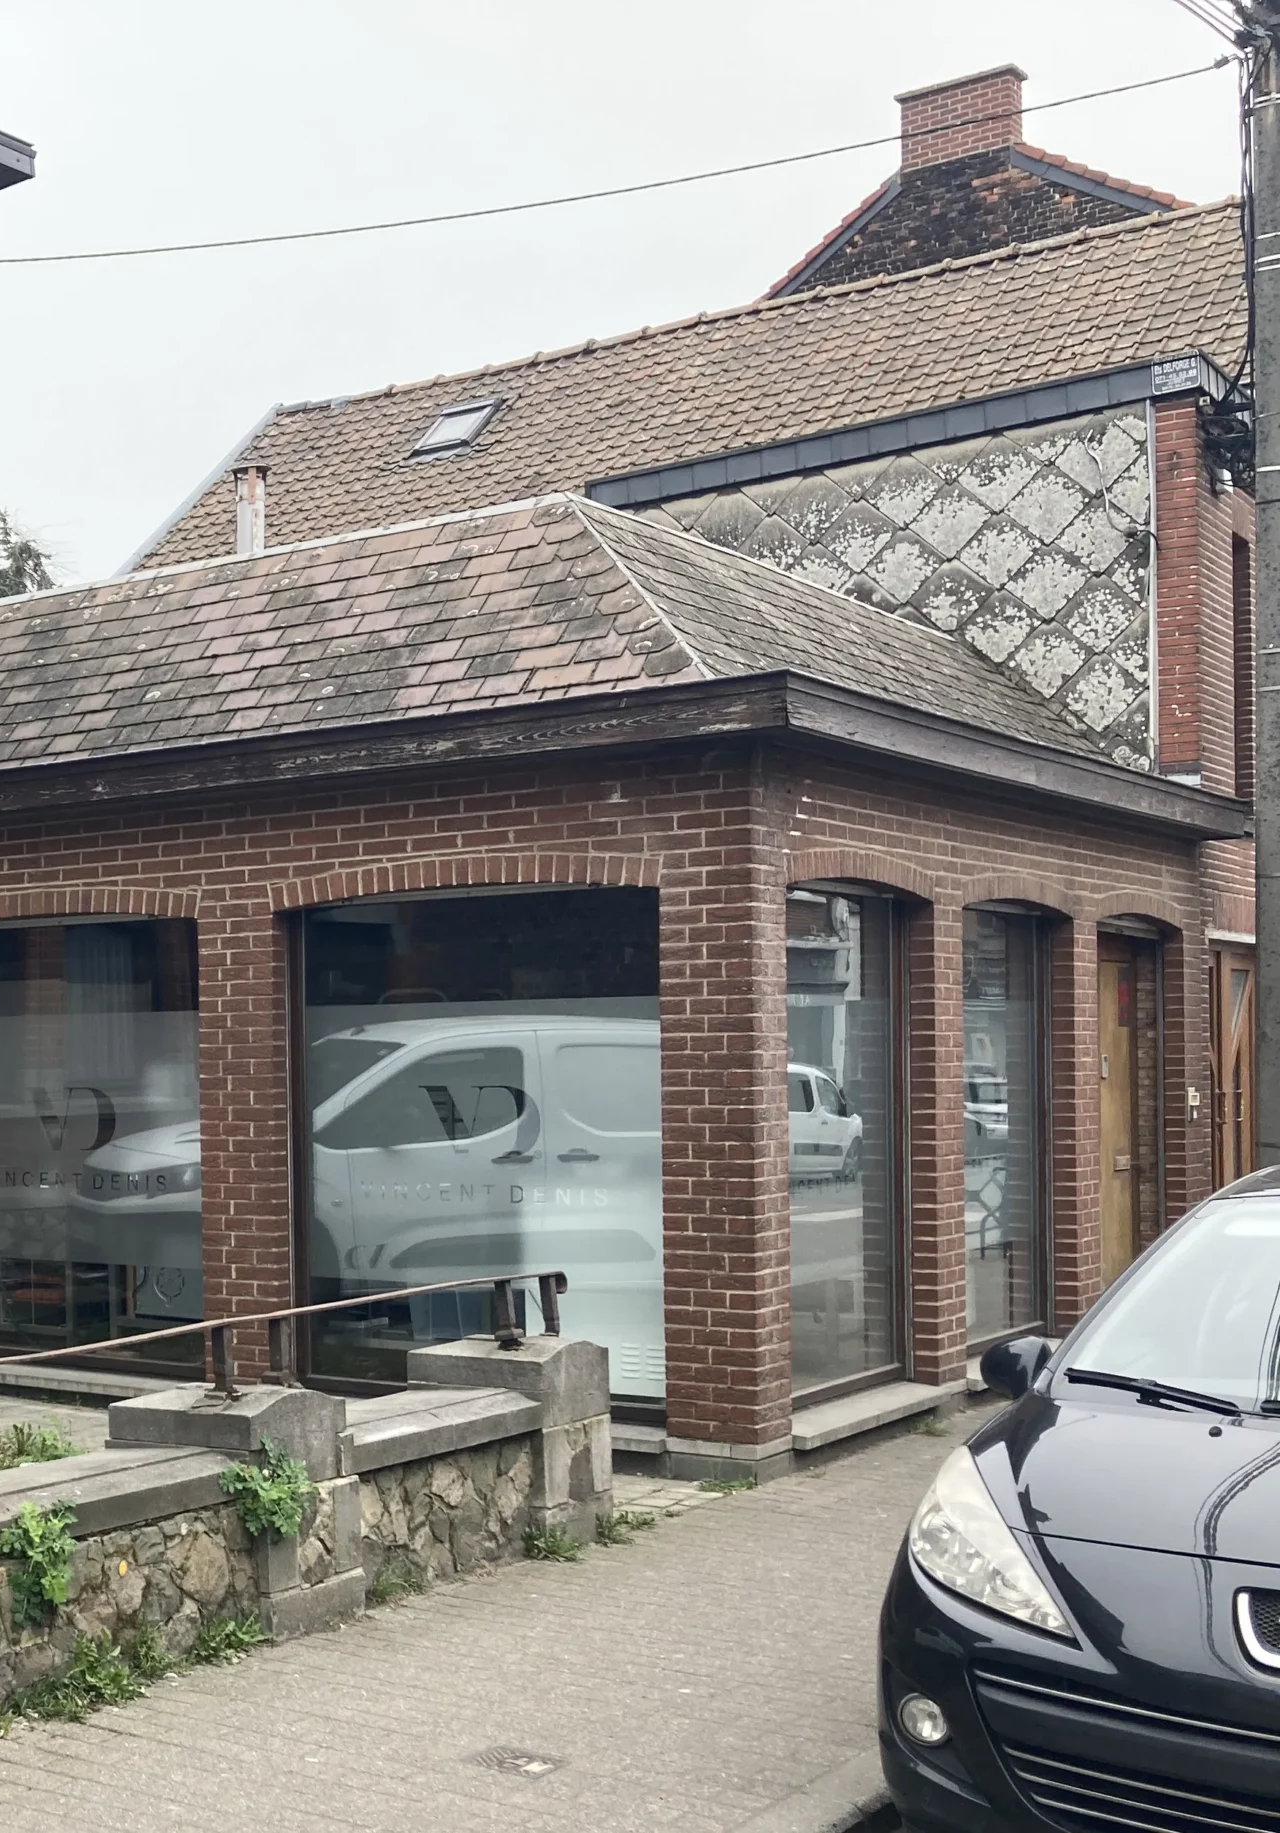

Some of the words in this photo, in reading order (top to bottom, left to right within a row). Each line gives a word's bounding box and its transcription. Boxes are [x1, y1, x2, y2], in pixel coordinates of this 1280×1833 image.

[1163, 358, 1190, 374] DELFORGE
[92, 1174, 167, 1191] DENIS
[360, 1180, 495, 1202] VINCENT
[510, 1184, 609, 1207] DENIS
